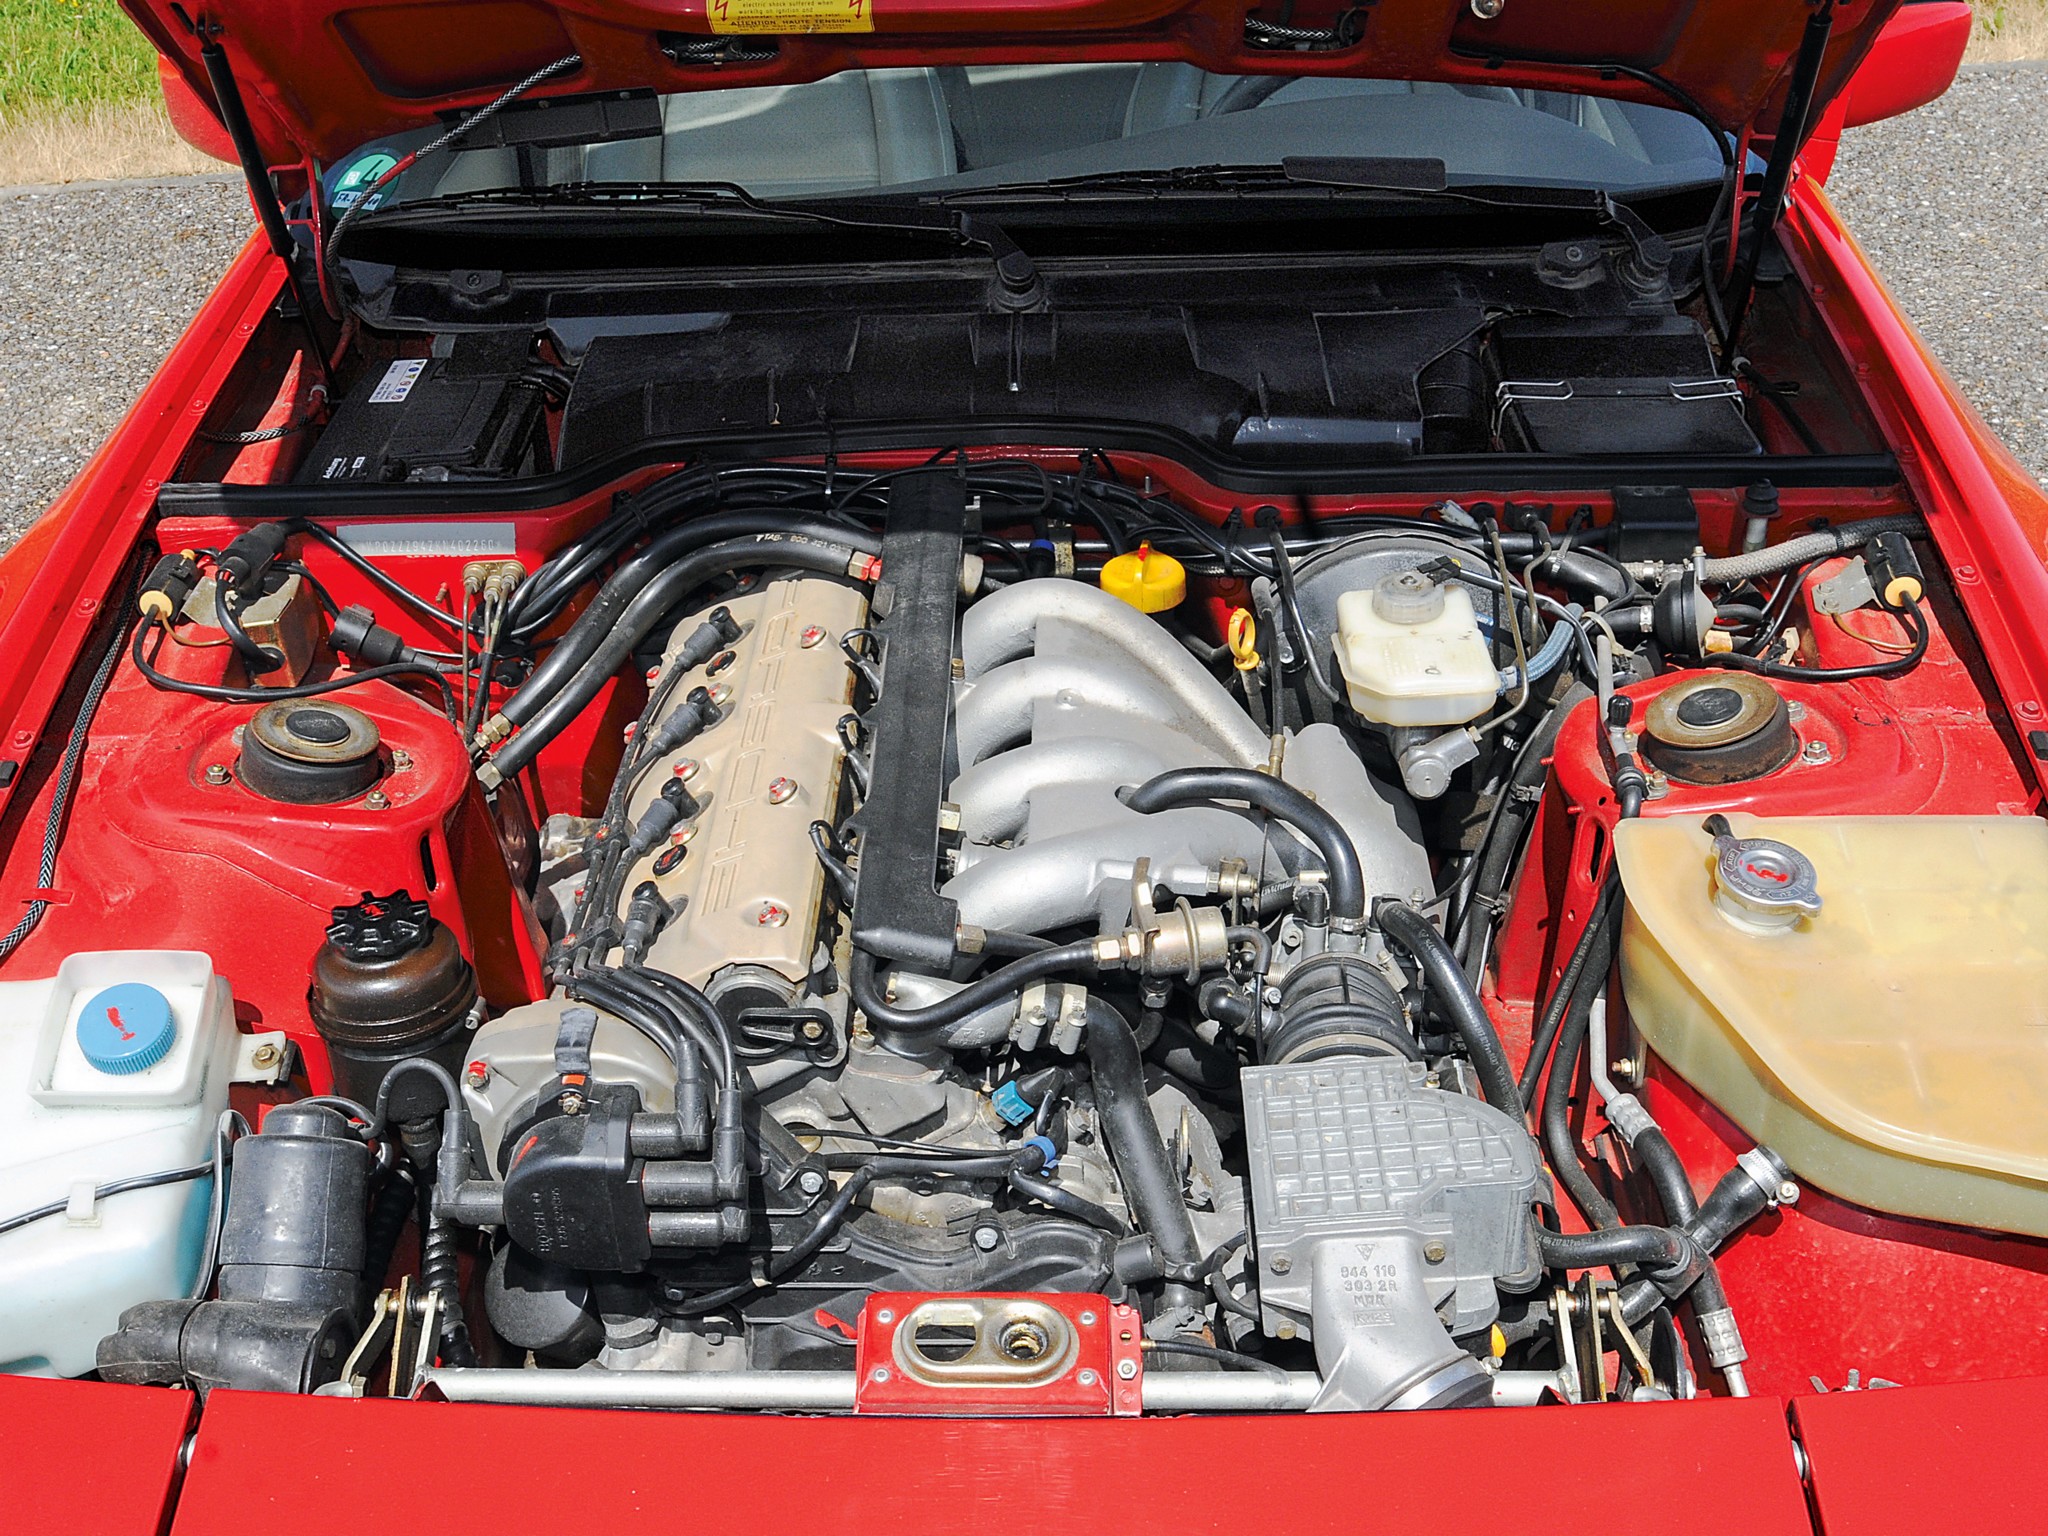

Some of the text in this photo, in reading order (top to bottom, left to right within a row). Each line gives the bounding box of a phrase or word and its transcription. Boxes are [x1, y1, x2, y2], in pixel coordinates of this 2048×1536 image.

[1727, 851, 1737, 866] AUF
[533, 1211, 551, 1252] BOSCH
[1340, 1264, 1397, 1279] 944 110
[1343, 1279, 1373, 1292] 303
